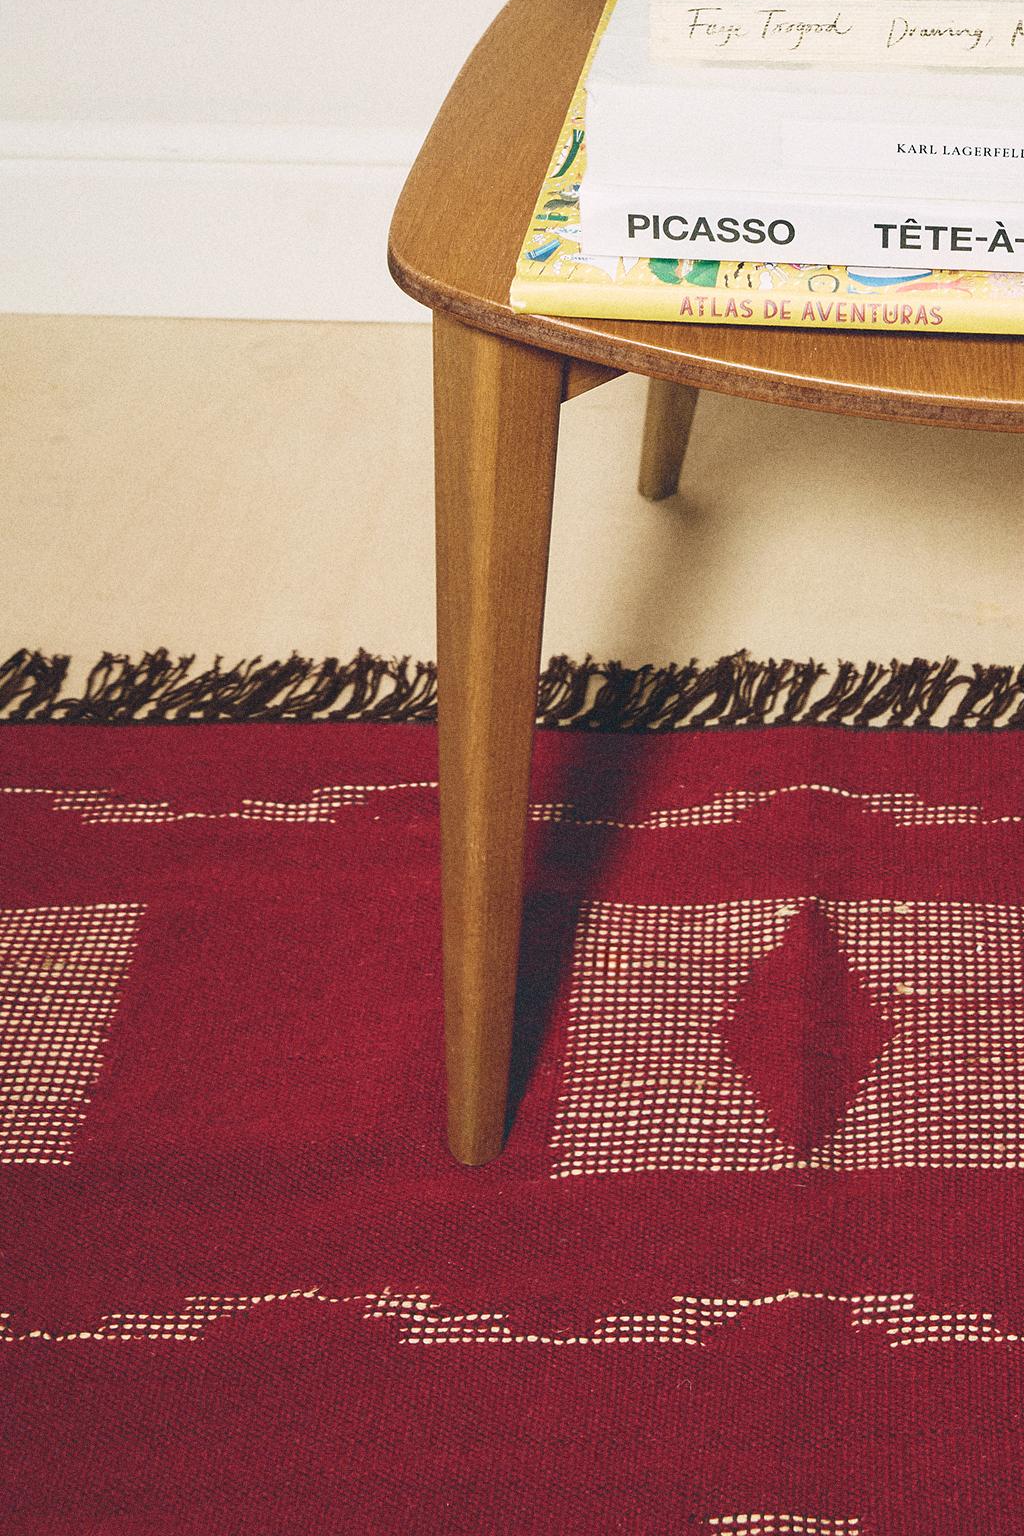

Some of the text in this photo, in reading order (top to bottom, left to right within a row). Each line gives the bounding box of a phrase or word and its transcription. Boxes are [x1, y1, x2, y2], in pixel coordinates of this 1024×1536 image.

[887, 17, 994, 51] Drawing,
[896, 143, 938, 155] KARL
[627, 213, 796, 246] PICASSO
[679, 296, 944, 327] ATLAS DE AVENTURAS
